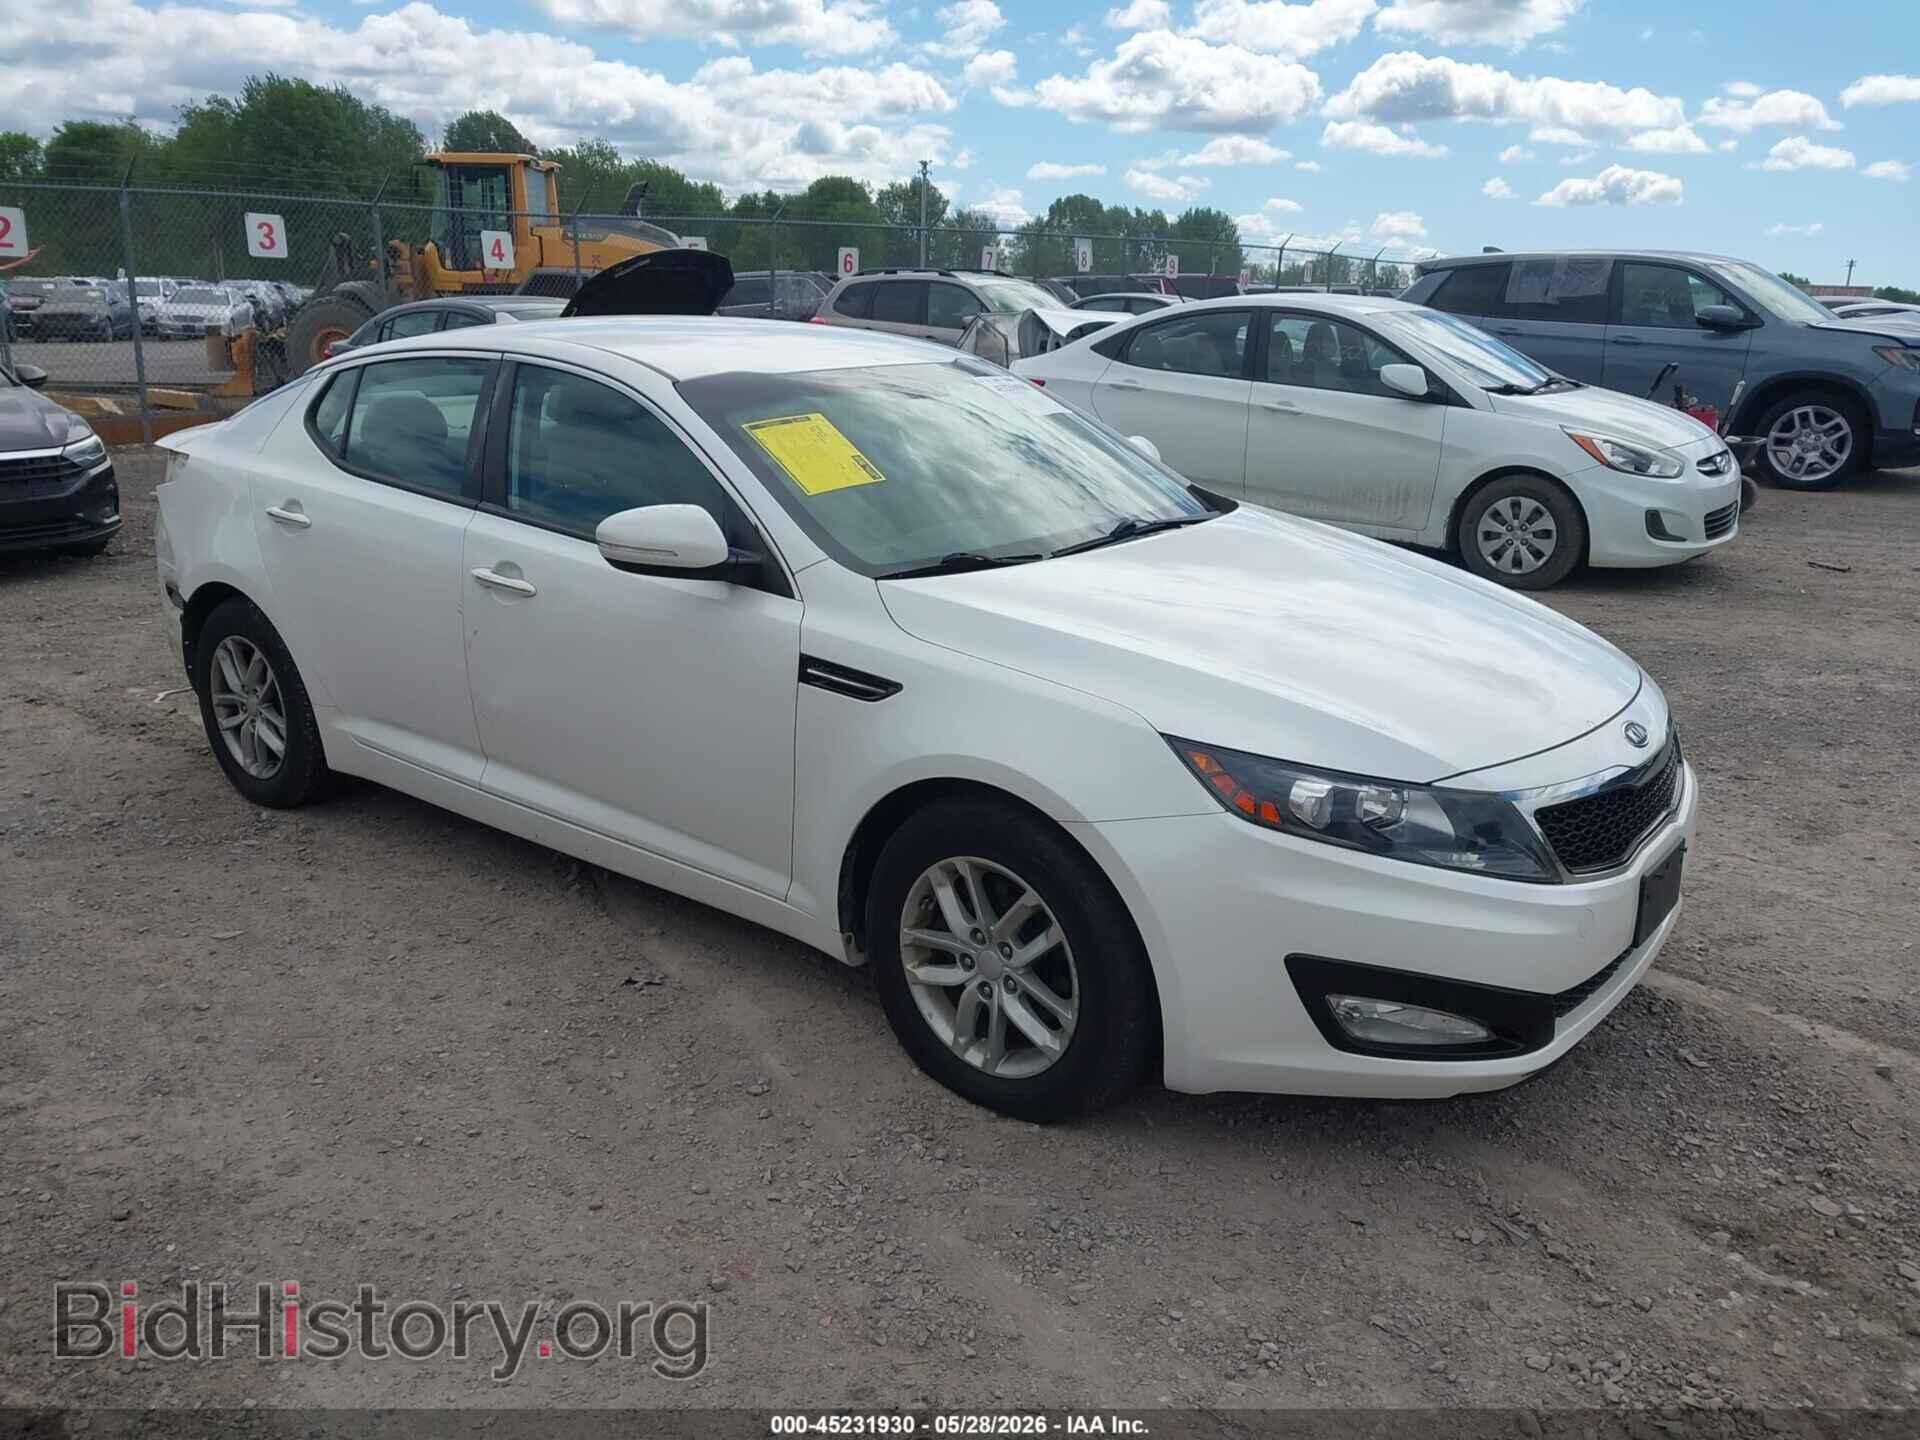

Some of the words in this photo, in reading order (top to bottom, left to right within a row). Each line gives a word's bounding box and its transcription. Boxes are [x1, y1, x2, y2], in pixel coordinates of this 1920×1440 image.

[0, 216, 15, 248] 2
[257, 222, 276, 250] 3
[491, 239, 504, 261] 4
[1081, 251, 1088, 268] 8
[844, 253, 853, 272] 6
[986, 251, 993, 270] 7
[1168, 259, 1176, 274] 9
